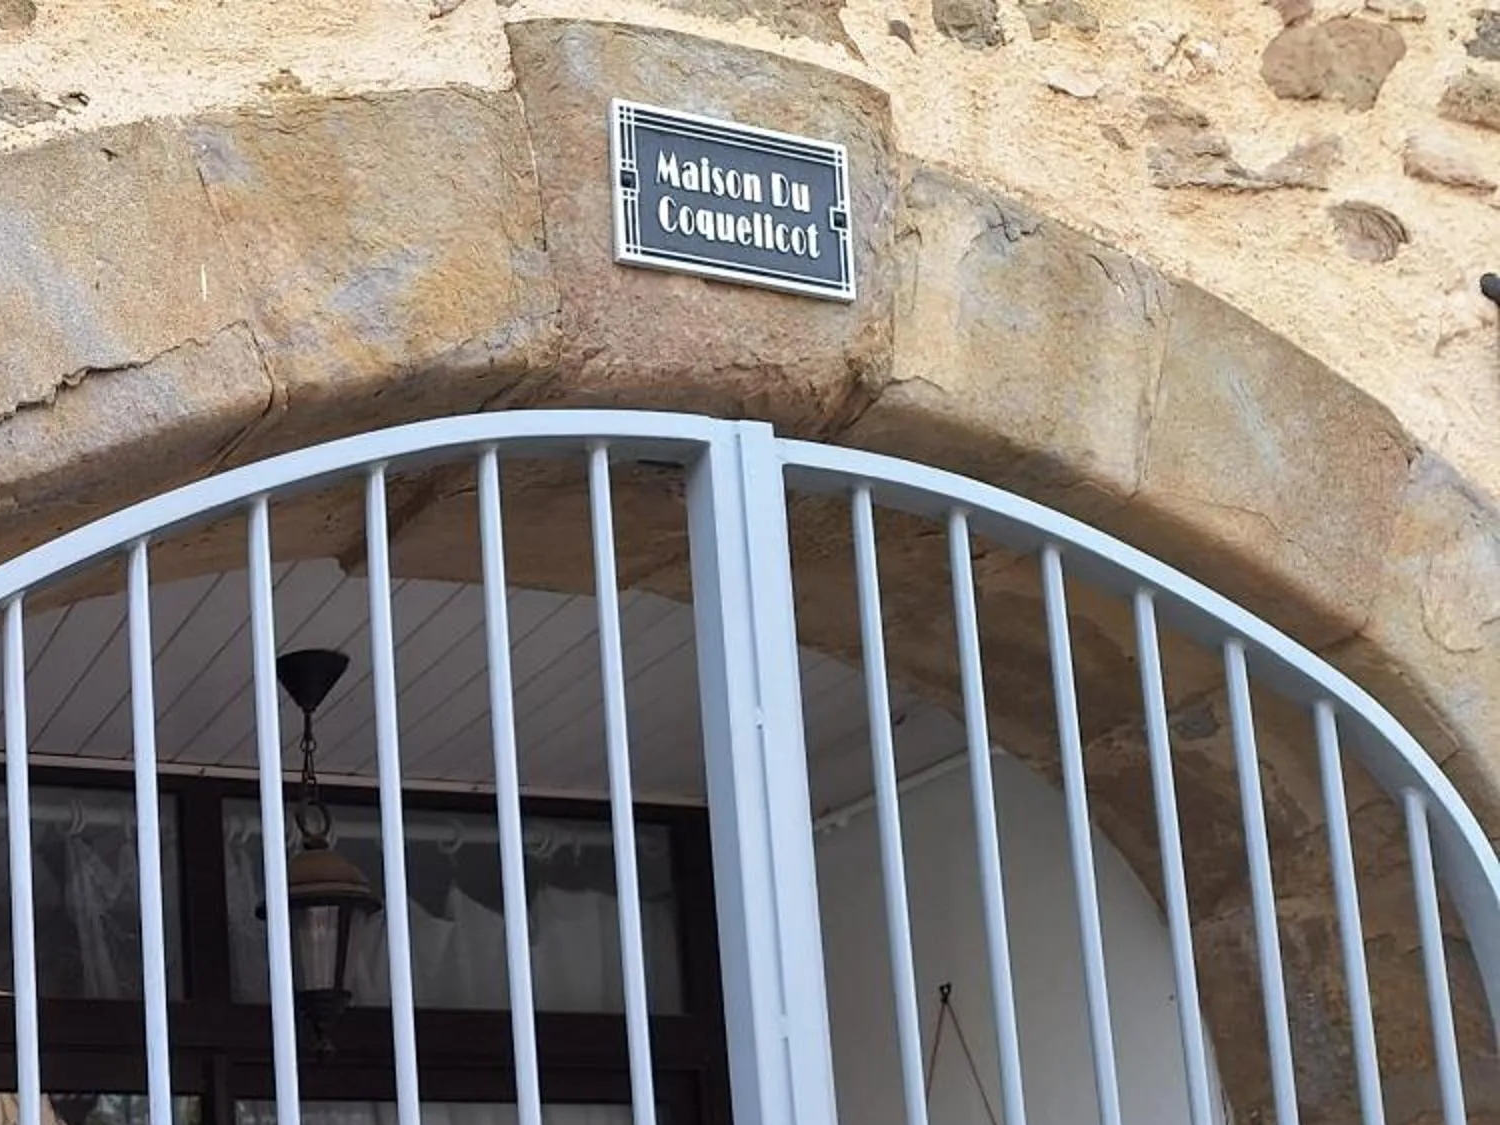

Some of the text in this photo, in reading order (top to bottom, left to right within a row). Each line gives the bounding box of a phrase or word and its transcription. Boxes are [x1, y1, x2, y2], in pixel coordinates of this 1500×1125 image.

[656, 150, 811, 213] Maison Du
[658, 195, 821, 260] Coquelicot
